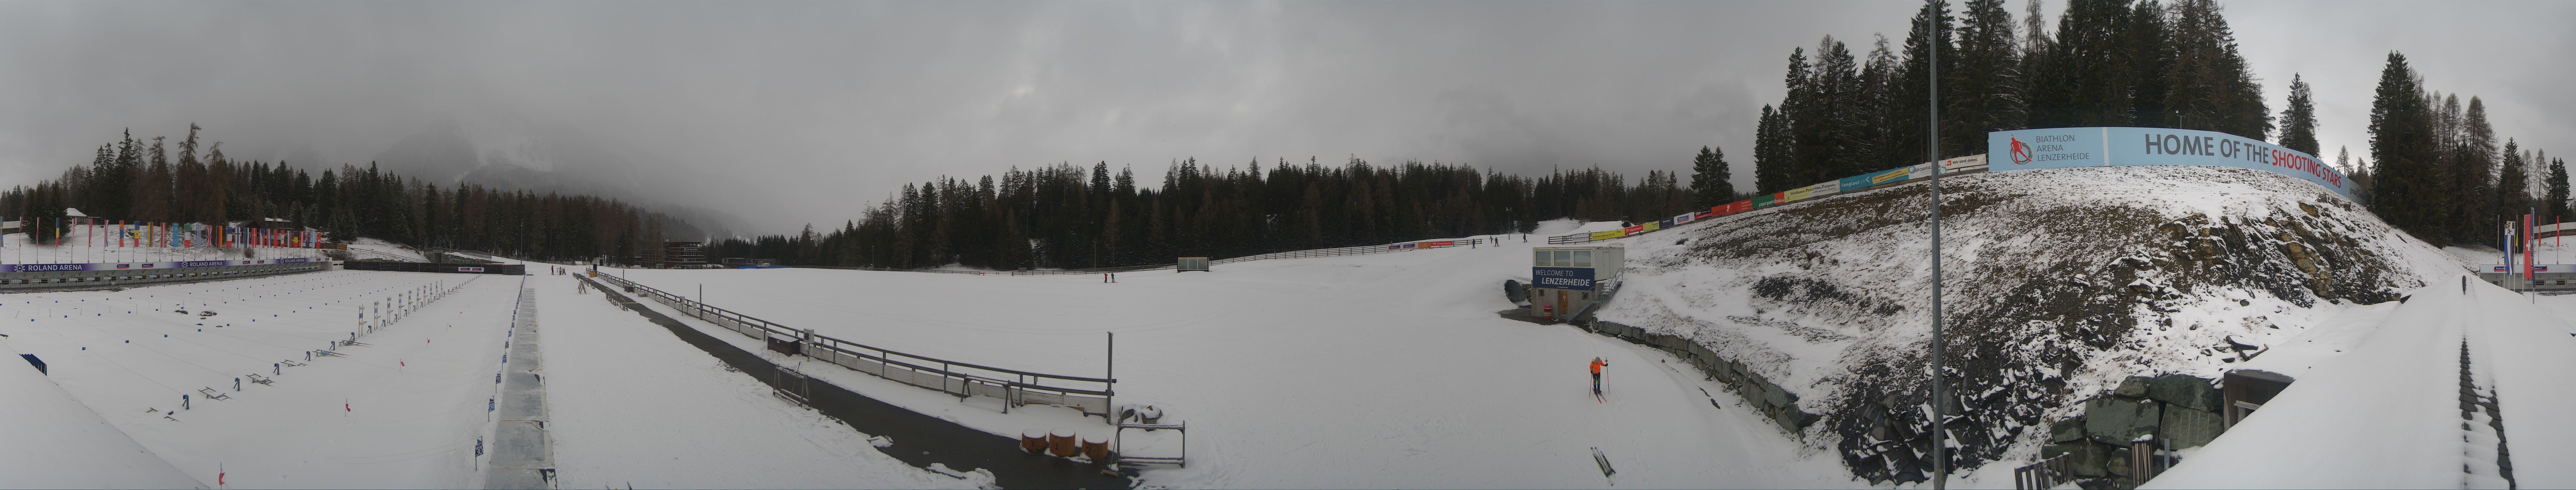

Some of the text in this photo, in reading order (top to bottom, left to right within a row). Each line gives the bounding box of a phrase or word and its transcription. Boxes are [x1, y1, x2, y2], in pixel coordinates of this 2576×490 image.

[2038, 153, 2089, 161] LENZERHEIDE
[2145, 134, 2341, 188] HOME OF THE SHOOTING STARS
[1759, 198, 1784, 207] parpanbau
[1541, 277, 1590, 286] LENZERHEIDE
[476, 447, 483, 456] 30
